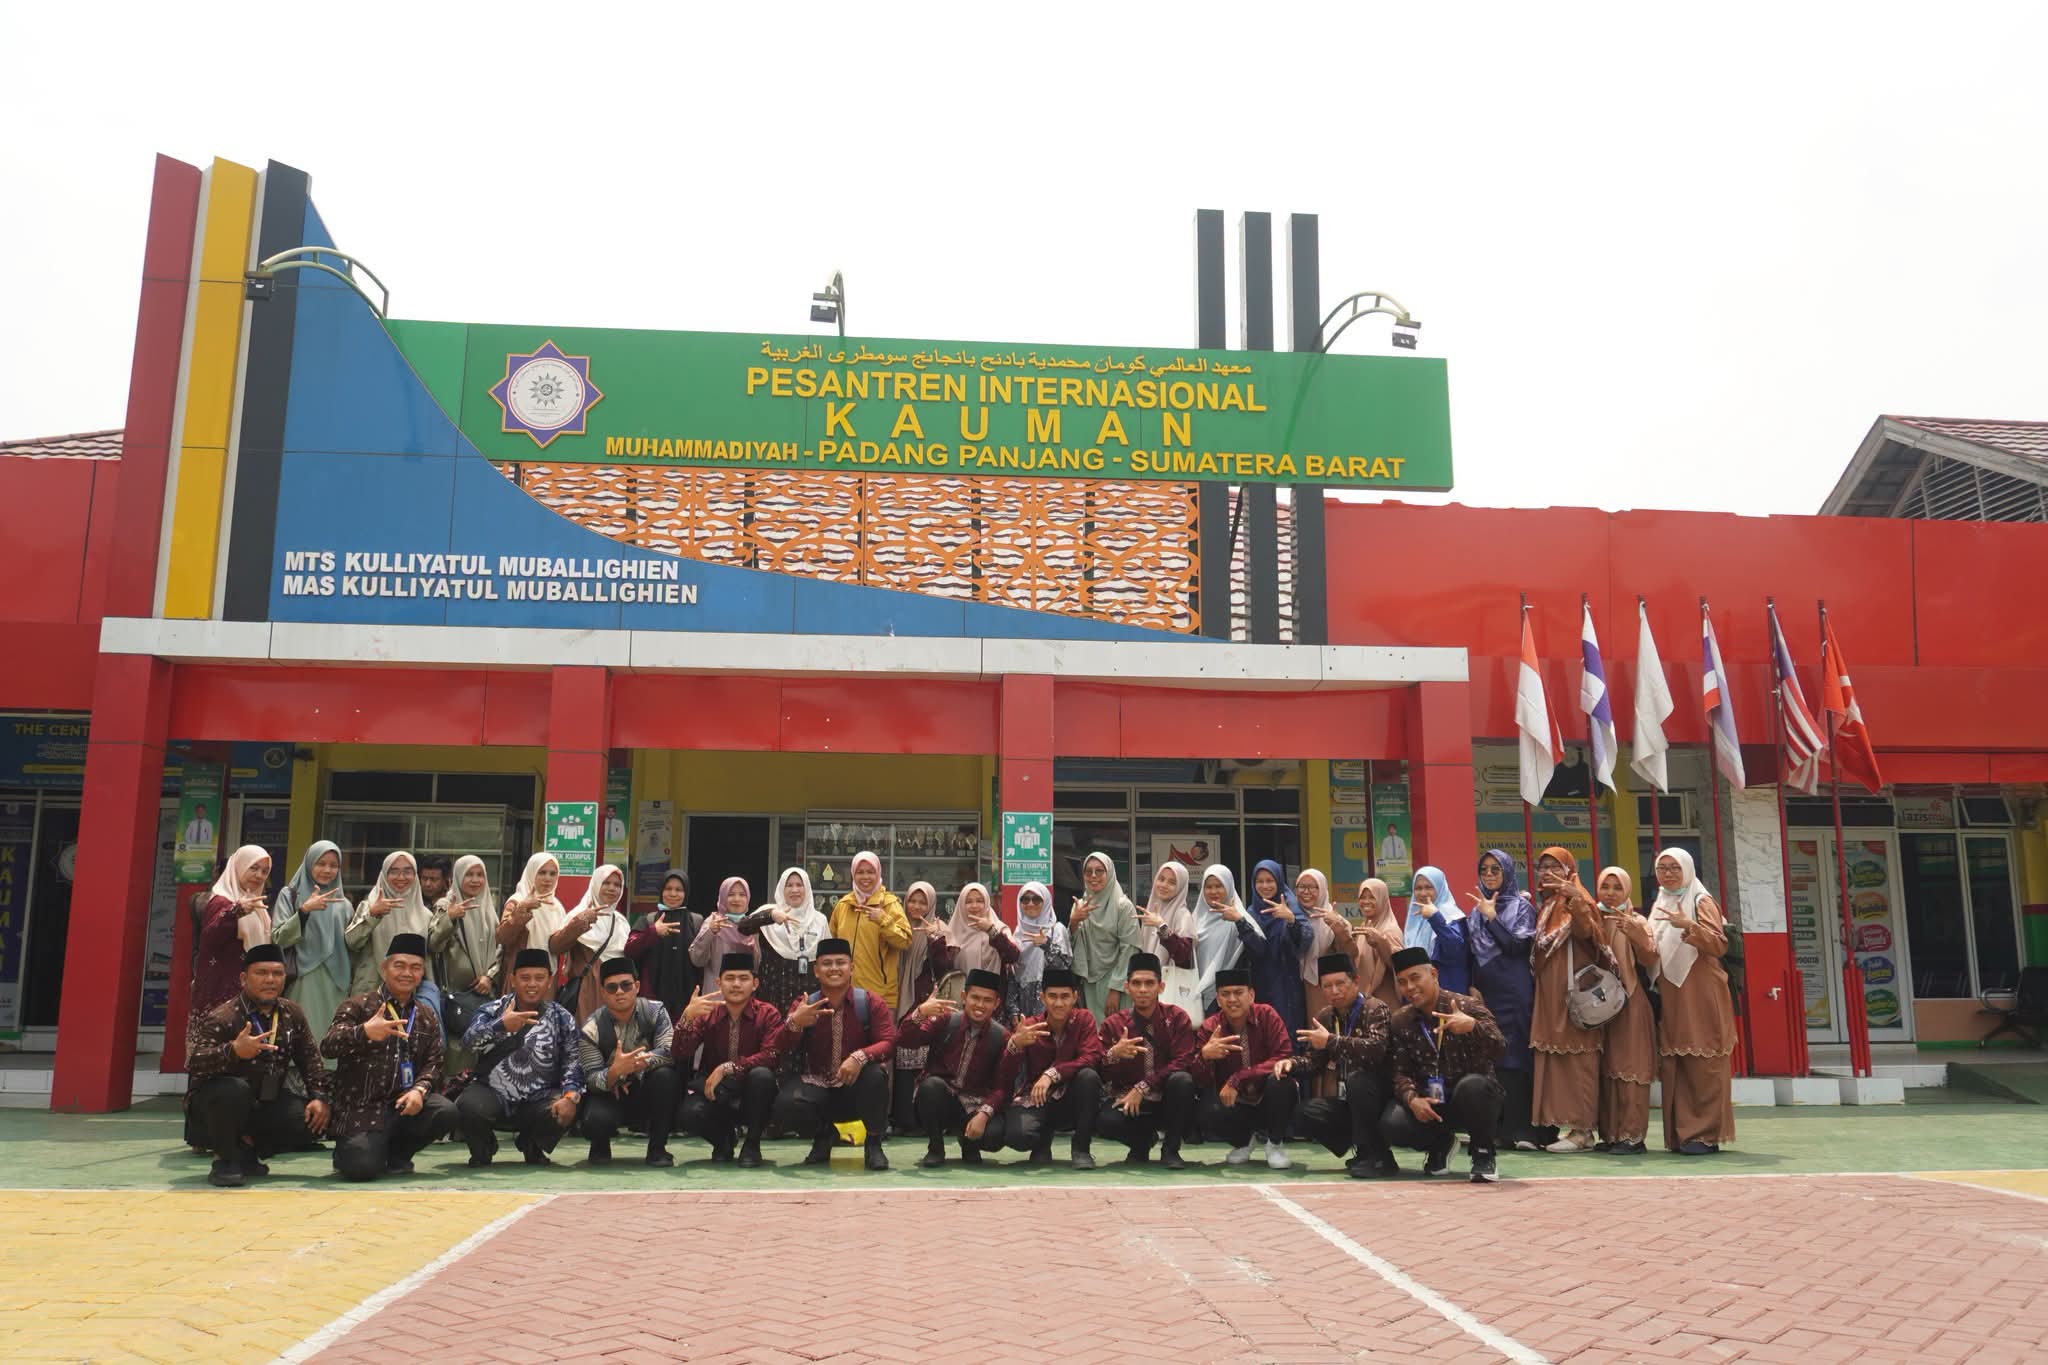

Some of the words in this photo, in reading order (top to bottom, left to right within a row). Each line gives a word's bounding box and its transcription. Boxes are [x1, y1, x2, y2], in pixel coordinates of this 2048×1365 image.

[746, 366, 967, 403] PESANTREN
[979, 375, 1268, 412] INTERNASIONAL
[605, 436, 799, 462] MUHAMMADIYAH
[818, 439, 949, 467] PADANG
[959, 445, 1106, 471] PANJANG
[1130, 449, 1298, 476] SUMATERA
[1305, 454, 1406, 480] BARAT
[284, 550, 336, 573] MTS
[344, 551, 493, 576] KULLIYATUL
[498, 555, 679, 581] MUBALLIGHIEN
[282, 574, 336, 596] MAS
[341, 575, 499, 600] KULLIYATUL
[506, 579, 698, 604] MUBALLIGHIEN
[15, 723, 43, 735] THE
